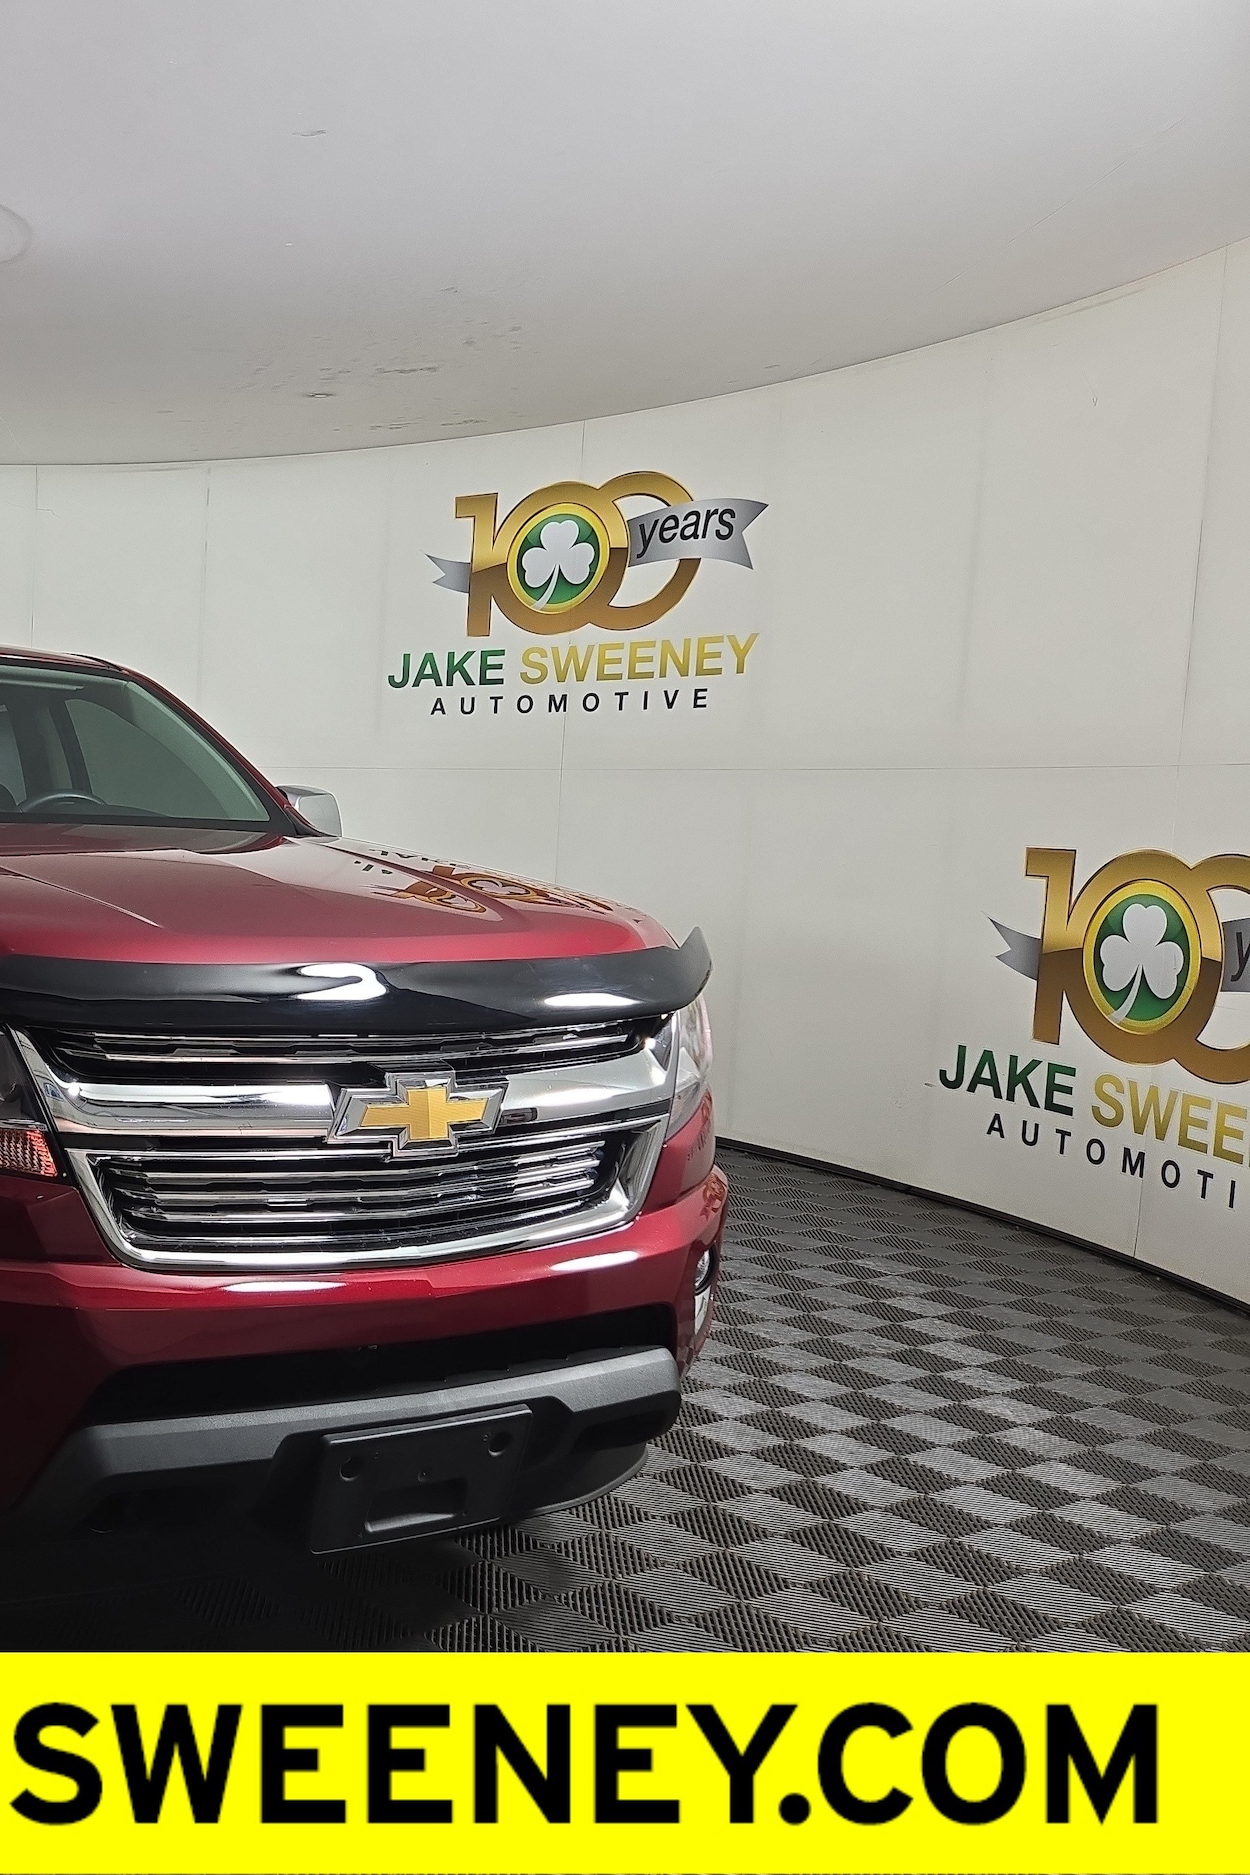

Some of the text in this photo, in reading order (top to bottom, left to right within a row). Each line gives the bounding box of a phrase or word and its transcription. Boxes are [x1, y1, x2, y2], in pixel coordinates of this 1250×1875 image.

[637, 506, 736, 559] years
[387, 632, 759, 689] JAKE SWEENEY
[430, 688, 709, 716] AUTOMOTIVE
[938, 1044, 1250, 1167] JAKE SWEE
[985, 1112, 1237, 1209] AUTOMOTI
